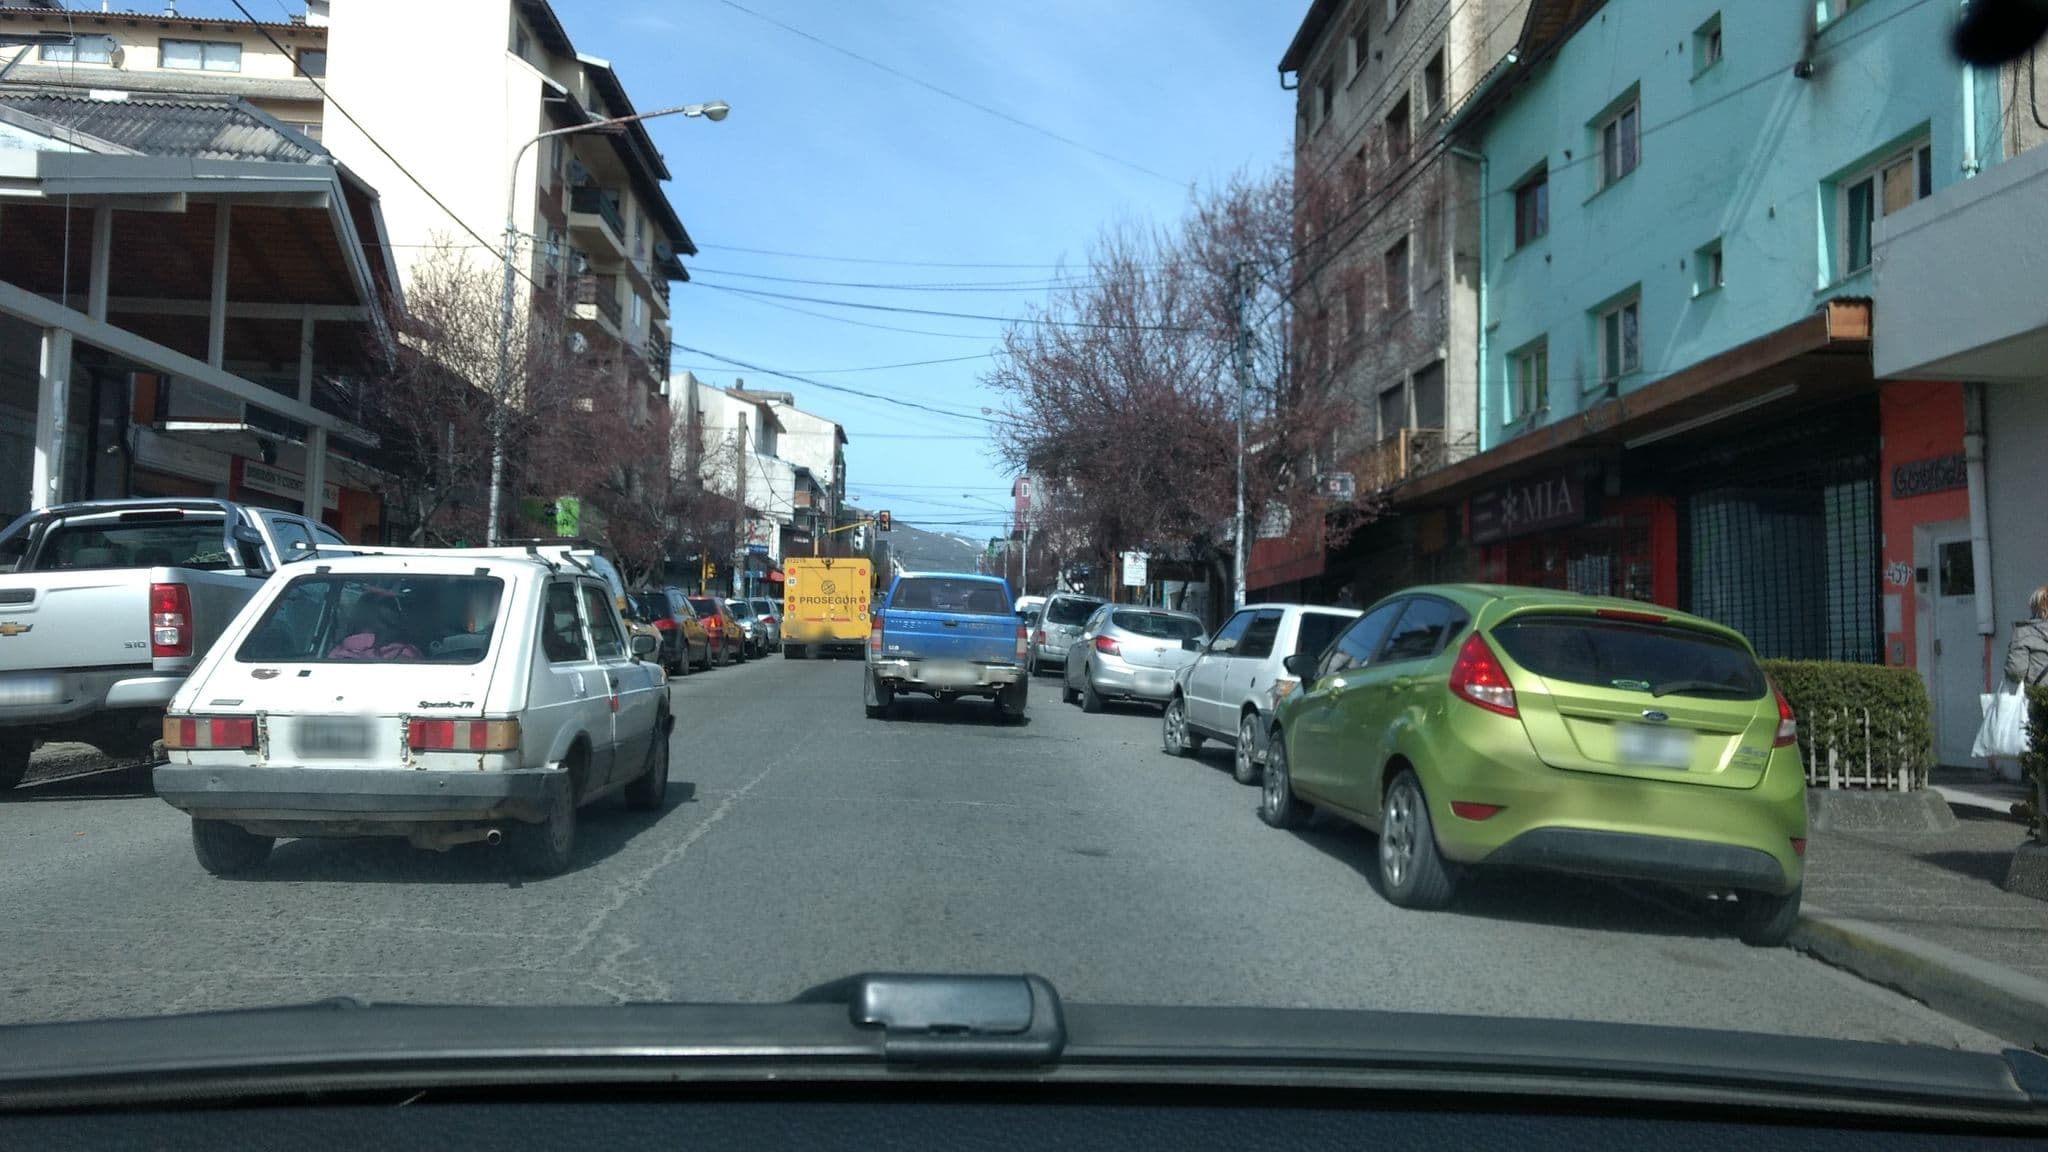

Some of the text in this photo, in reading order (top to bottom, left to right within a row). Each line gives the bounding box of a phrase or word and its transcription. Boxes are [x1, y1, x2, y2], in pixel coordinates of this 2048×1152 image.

[1521, 476, 1573, 523] MIA
[1887, 563, 1909, 584] 459
[800, 597, 857, 605] PROSEGUR
